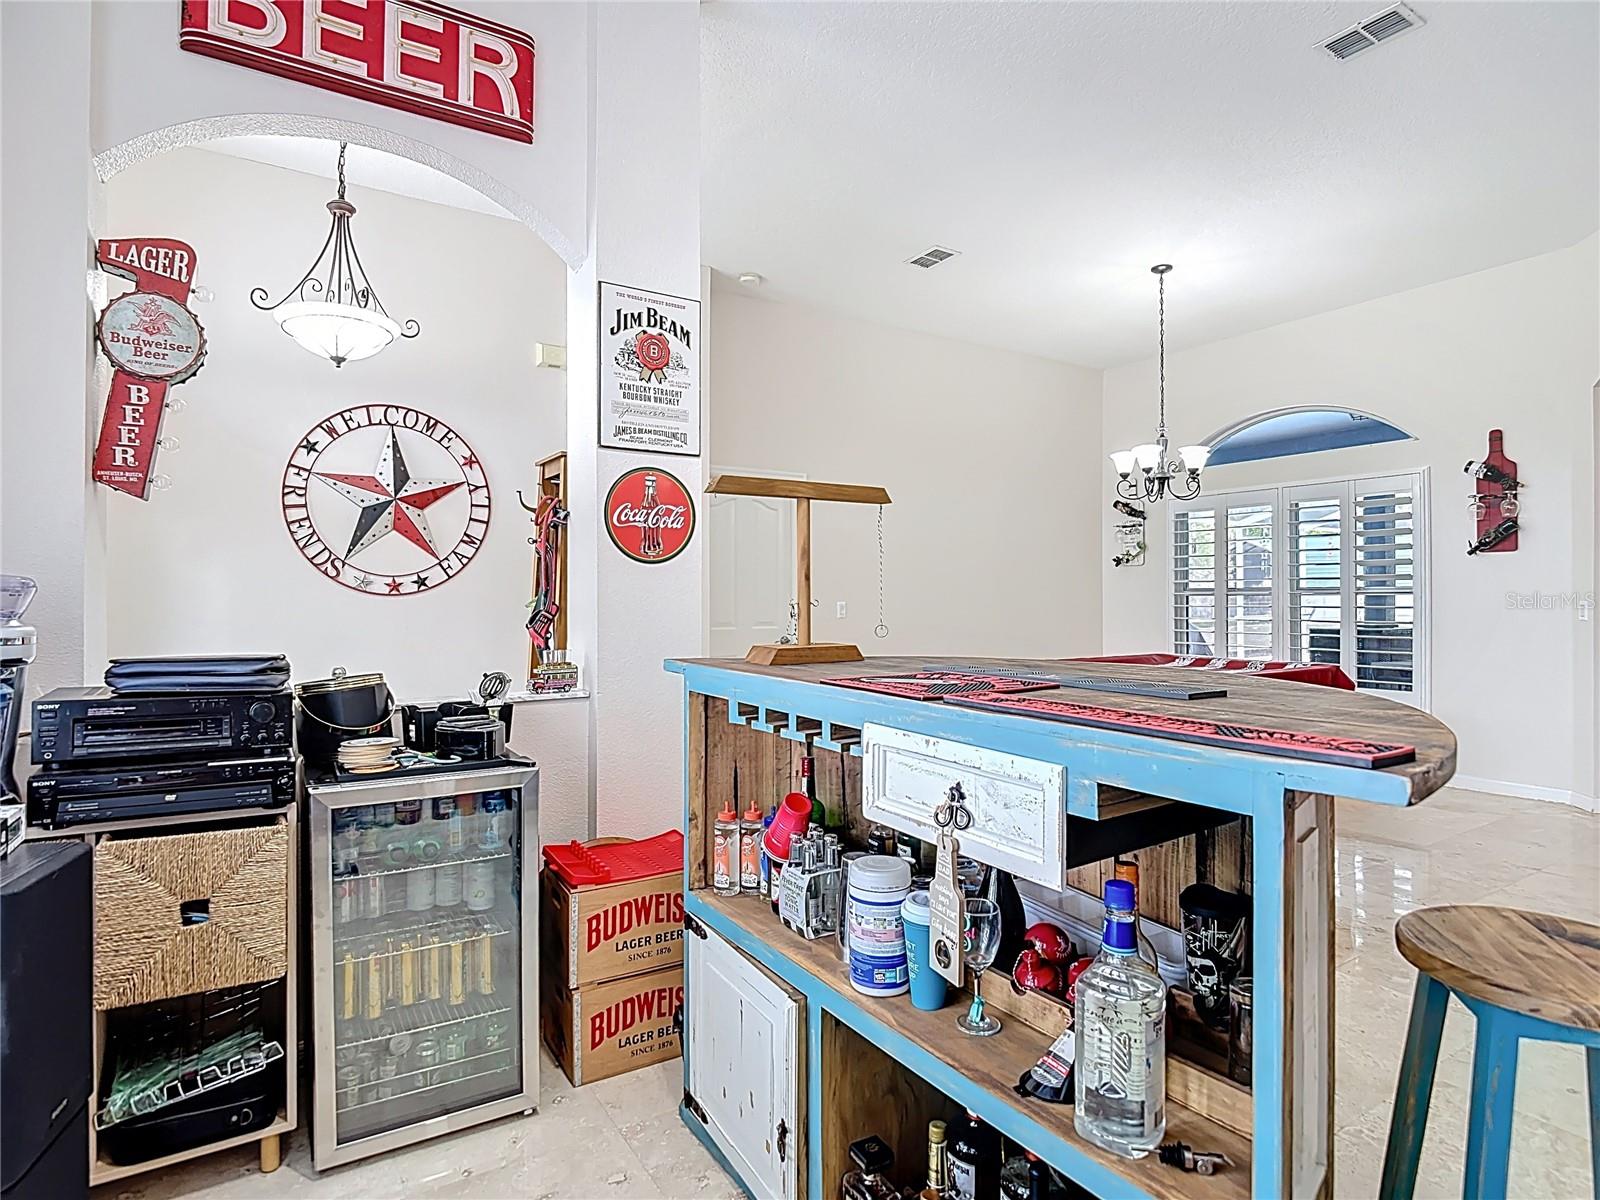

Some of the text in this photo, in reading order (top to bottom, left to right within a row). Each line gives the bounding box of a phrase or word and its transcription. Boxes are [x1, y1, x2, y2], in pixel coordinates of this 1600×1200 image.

[107, 242, 189, 283] LAGER
[610, 306, 692, 352] JIM BEAM
[110, 331, 193, 354] Budweiser
[133, 346, 169, 361] Beer
[619, 382, 683, 399] KENTUCKY STRAIGHT
[622, 391, 680, 407] BOURBON WHISKEY
[112, 384, 150, 467] BEER
[319, 405, 458, 451] WELCOME
[613, 425, 633, 438] JAMES
[637, 427, 653, 436] BEAM
[652, 429, 680, 442] DISTILLING
[282, 463, 346, 579] FRIENDS
[612, 502, 688, 529] Coca-Cola
[438, 481, 491, 580] FAMILY
[615, 929, 684, 953] LAGER BEER
[628, 946, 672, 962] SINCE 1876
[618, 1030, 654, 1049] LAGER
[630, 1040, 674, 1058] SINCE 1876
